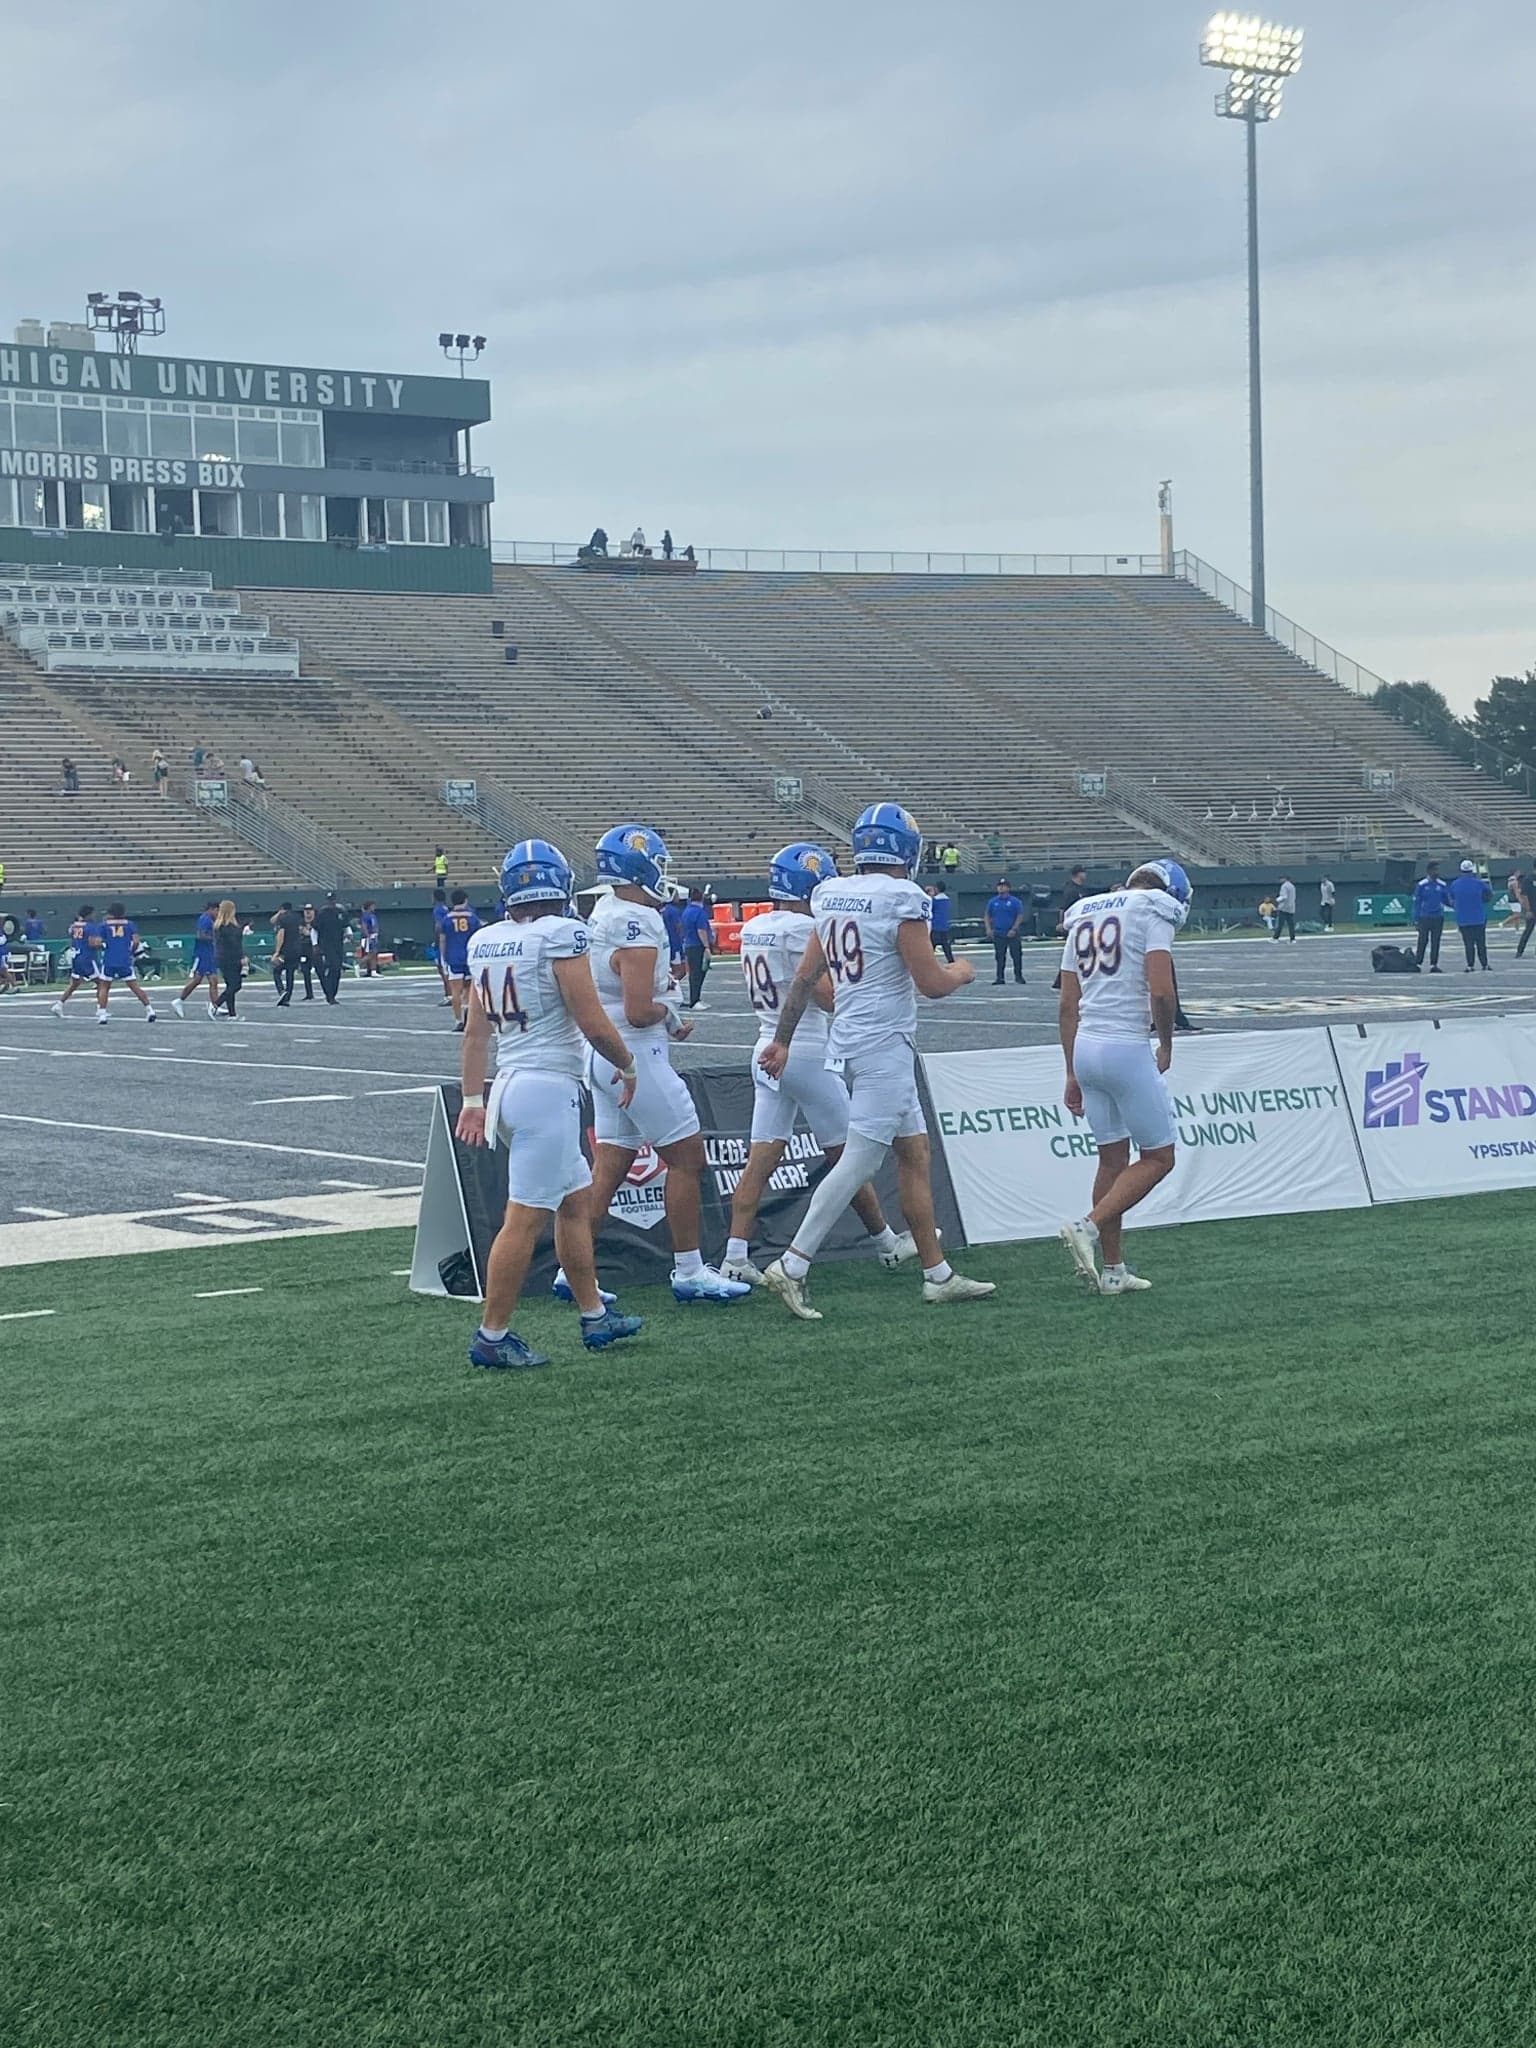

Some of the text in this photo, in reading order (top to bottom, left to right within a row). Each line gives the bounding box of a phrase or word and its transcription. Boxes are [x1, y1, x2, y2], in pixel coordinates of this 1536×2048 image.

[157, 362, 403, 409] UNIVERSITY
[1, 450, 245, 488] MORRIS PRESS BOX
[821, 897, 872, 914] CARRIZOSA
[1080, 897, 1128, 914] BROWN
[1357, 899, 1373, 915] E
[452, 917, 469, 932] 18
[473, 941, 523, 959] AGUILERA
[826, 919, 863, 983] 49
[1075, 916, 1121, 978] 99
[480, 965, 528, 1034] 44
[1200, 1085, 1339, 1116] UNIVERSITY
[938, 1105, 1062, 1136] EASTERN
[1178, 1121, 1258, 1147] UNION
